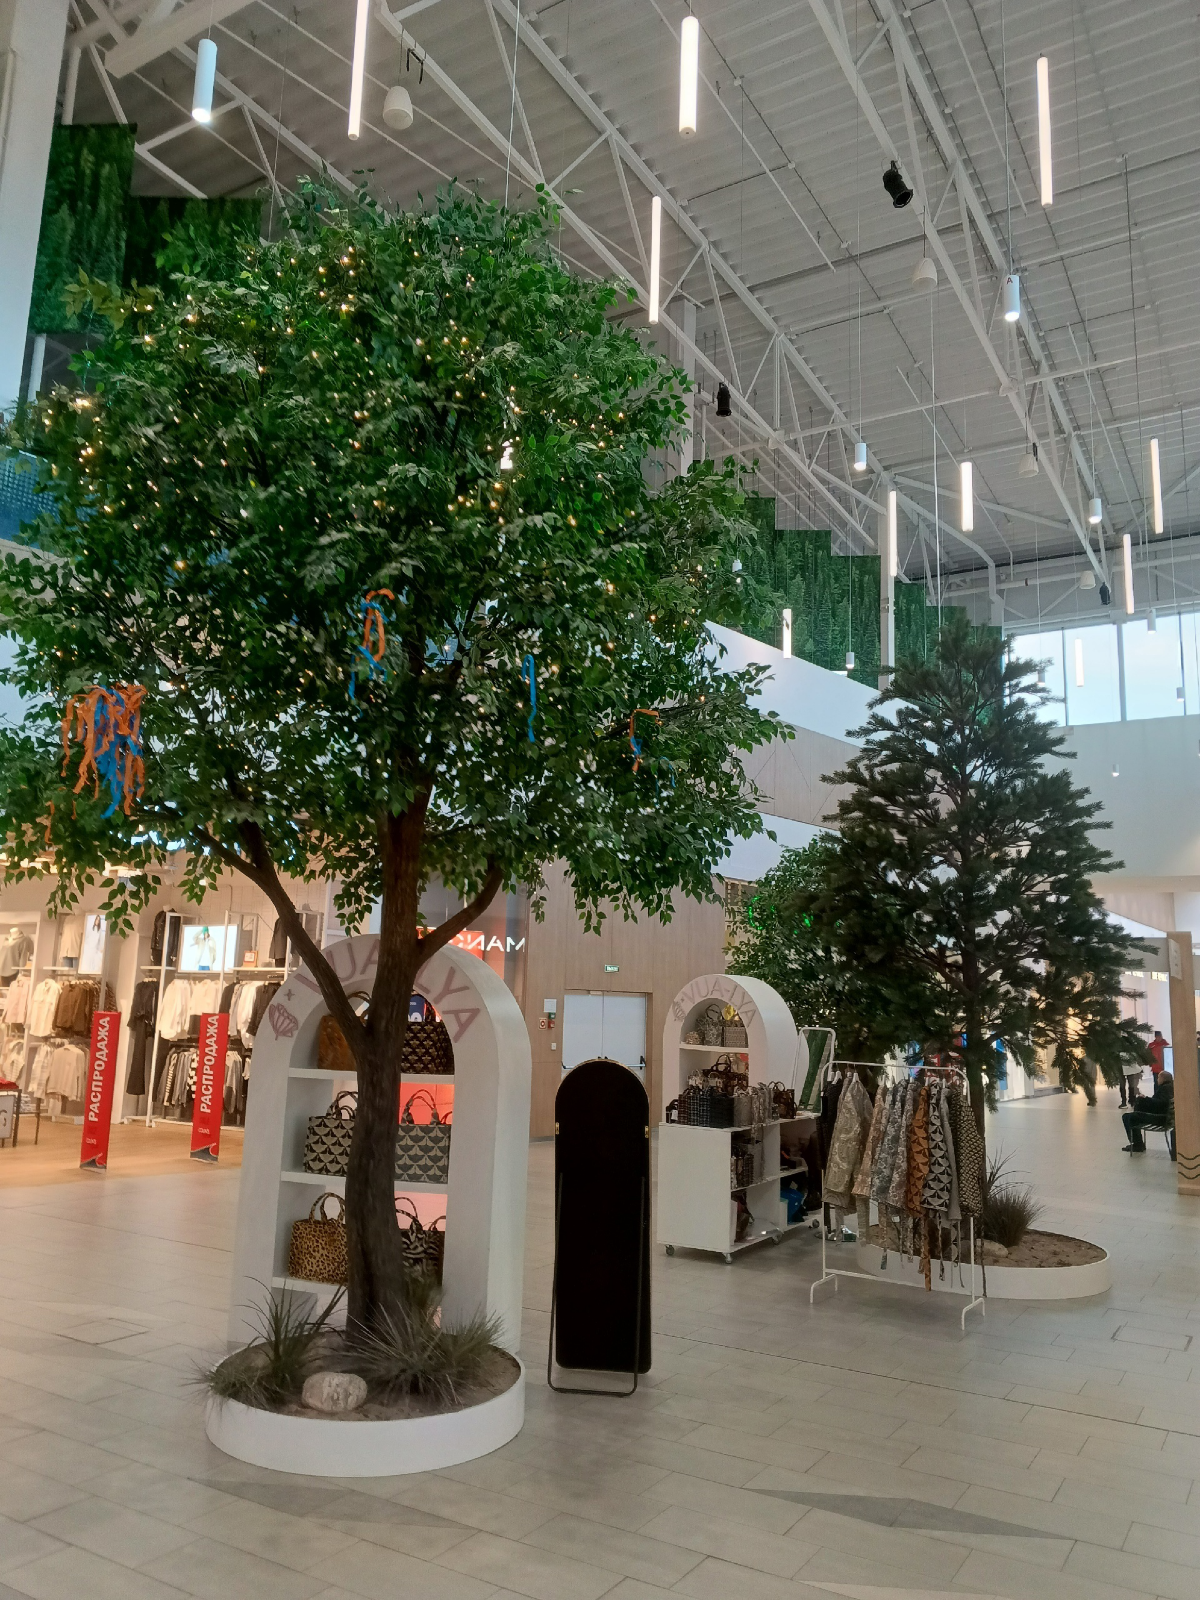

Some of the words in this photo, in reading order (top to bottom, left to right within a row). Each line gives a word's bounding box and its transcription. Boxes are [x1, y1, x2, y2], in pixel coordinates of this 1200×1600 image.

[681, 976, 757, 1028] VUA-LYA
[89, 1017, 110, 1122] РАСПРОДАЖА
[201, 1015, 219, 1113] РАСПРОДАЖА
